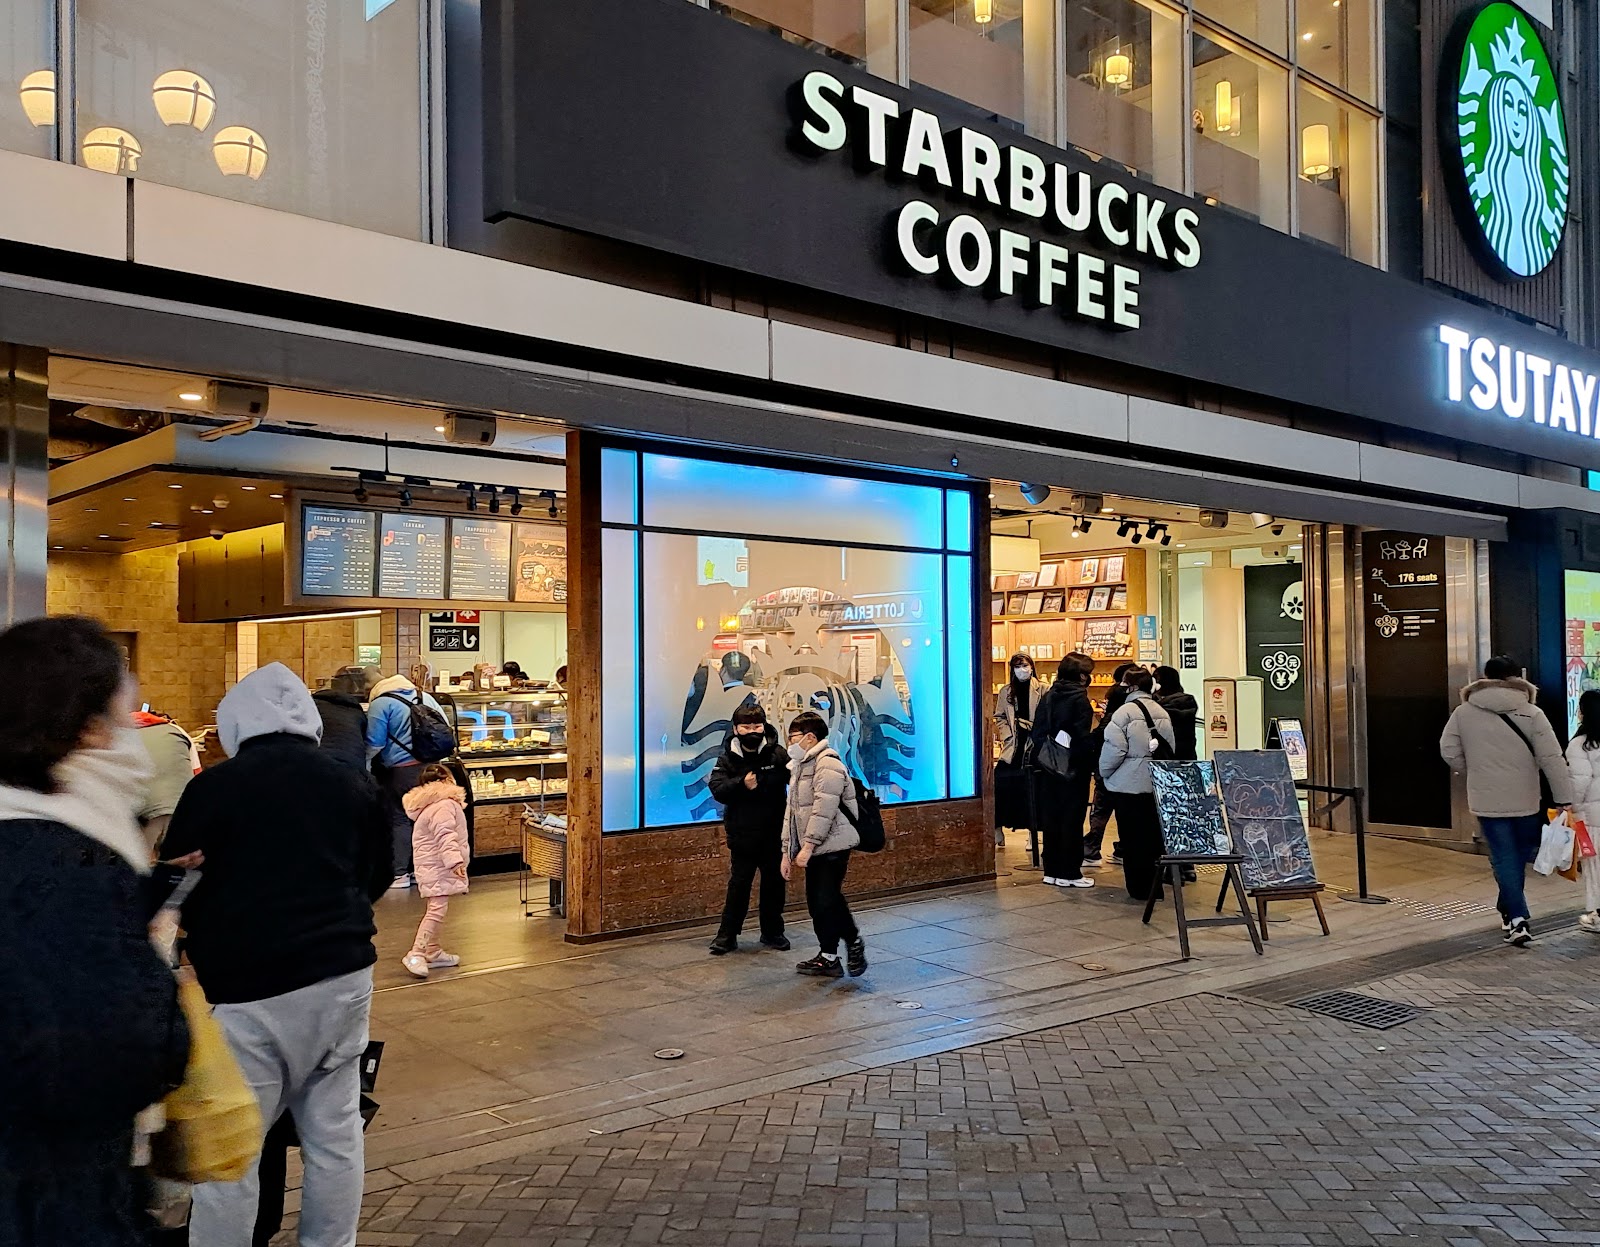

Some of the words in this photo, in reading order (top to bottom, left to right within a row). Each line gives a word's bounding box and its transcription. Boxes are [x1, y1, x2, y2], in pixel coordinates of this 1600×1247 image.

[802, 71, 1200, 268] STARBUCKS
[897, 200, 1140, 329] COFFEE
[1439, 324, 1600, 440] TSUTAY
[314, 515, 340, 523] ESPRESSO
[1371, 567, 1384, 577] 2F
[1398, 573, 1415, 583] 176
[1416, 573, 1438, 582] seats
[1372, 592, 1383, 602] 1F
